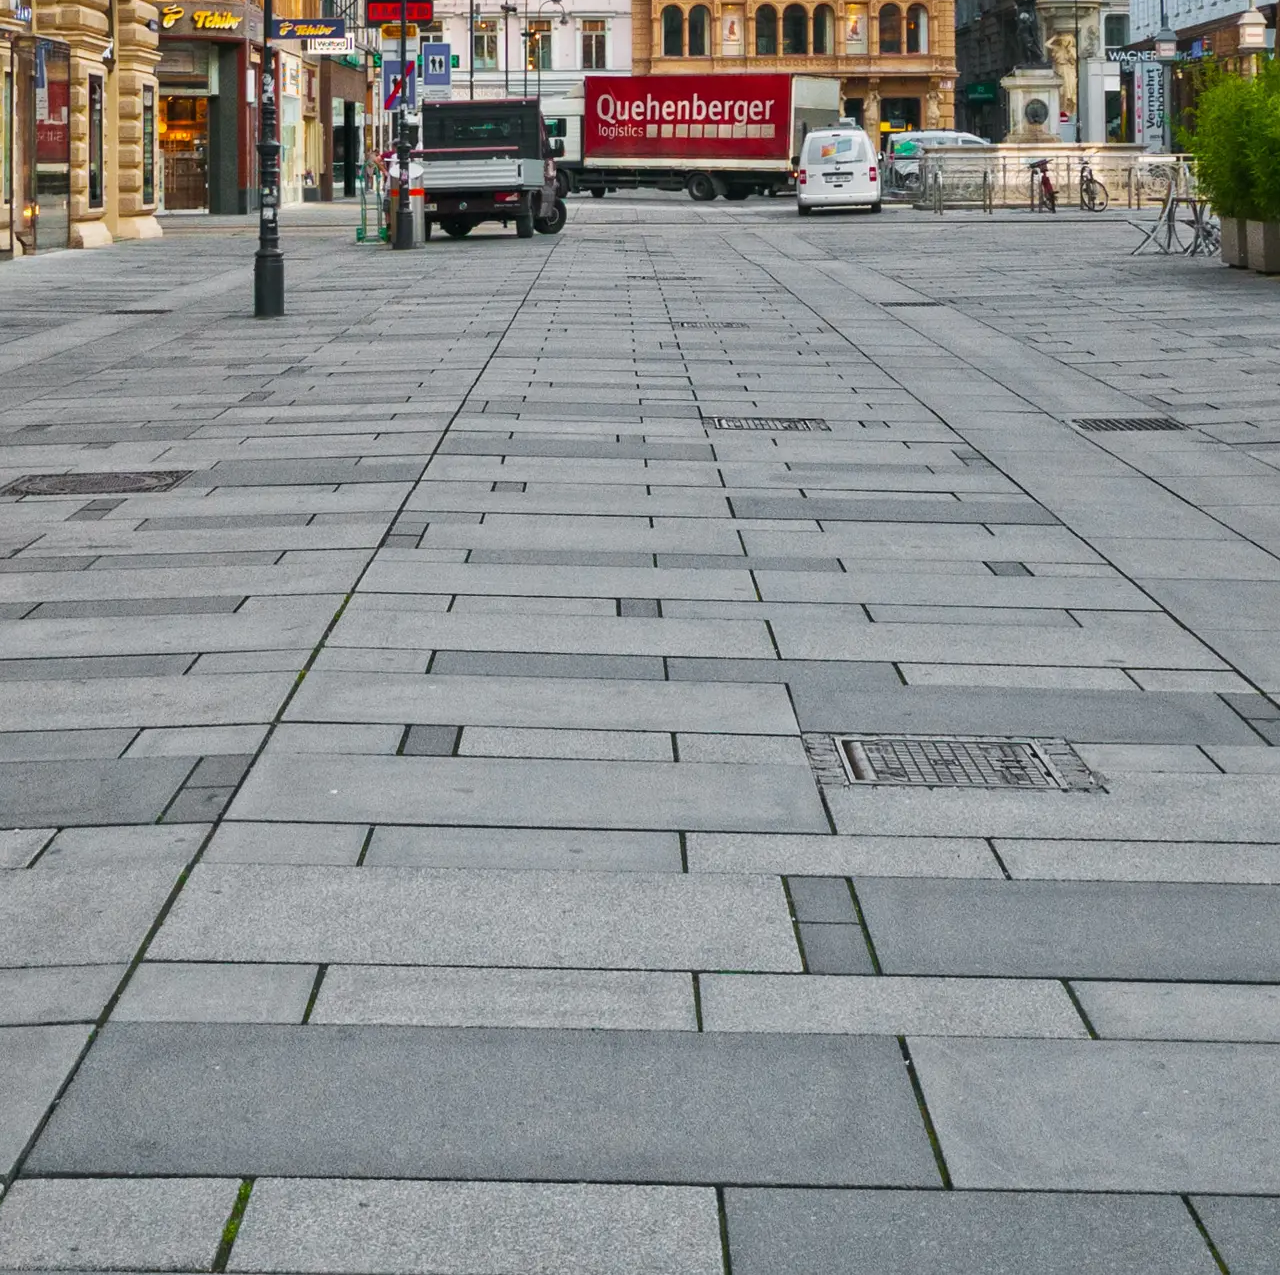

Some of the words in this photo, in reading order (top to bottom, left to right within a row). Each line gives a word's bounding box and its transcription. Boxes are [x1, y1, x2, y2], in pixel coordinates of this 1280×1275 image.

[193, 9, 244, 31] Tchibo
[294, 24, 336, 36] Tchibo
[1108, 49, 1157, 62] WAGNER
[596, 92, 775, 125] Quehenberger
[598, 122, 645, 140] logistics
